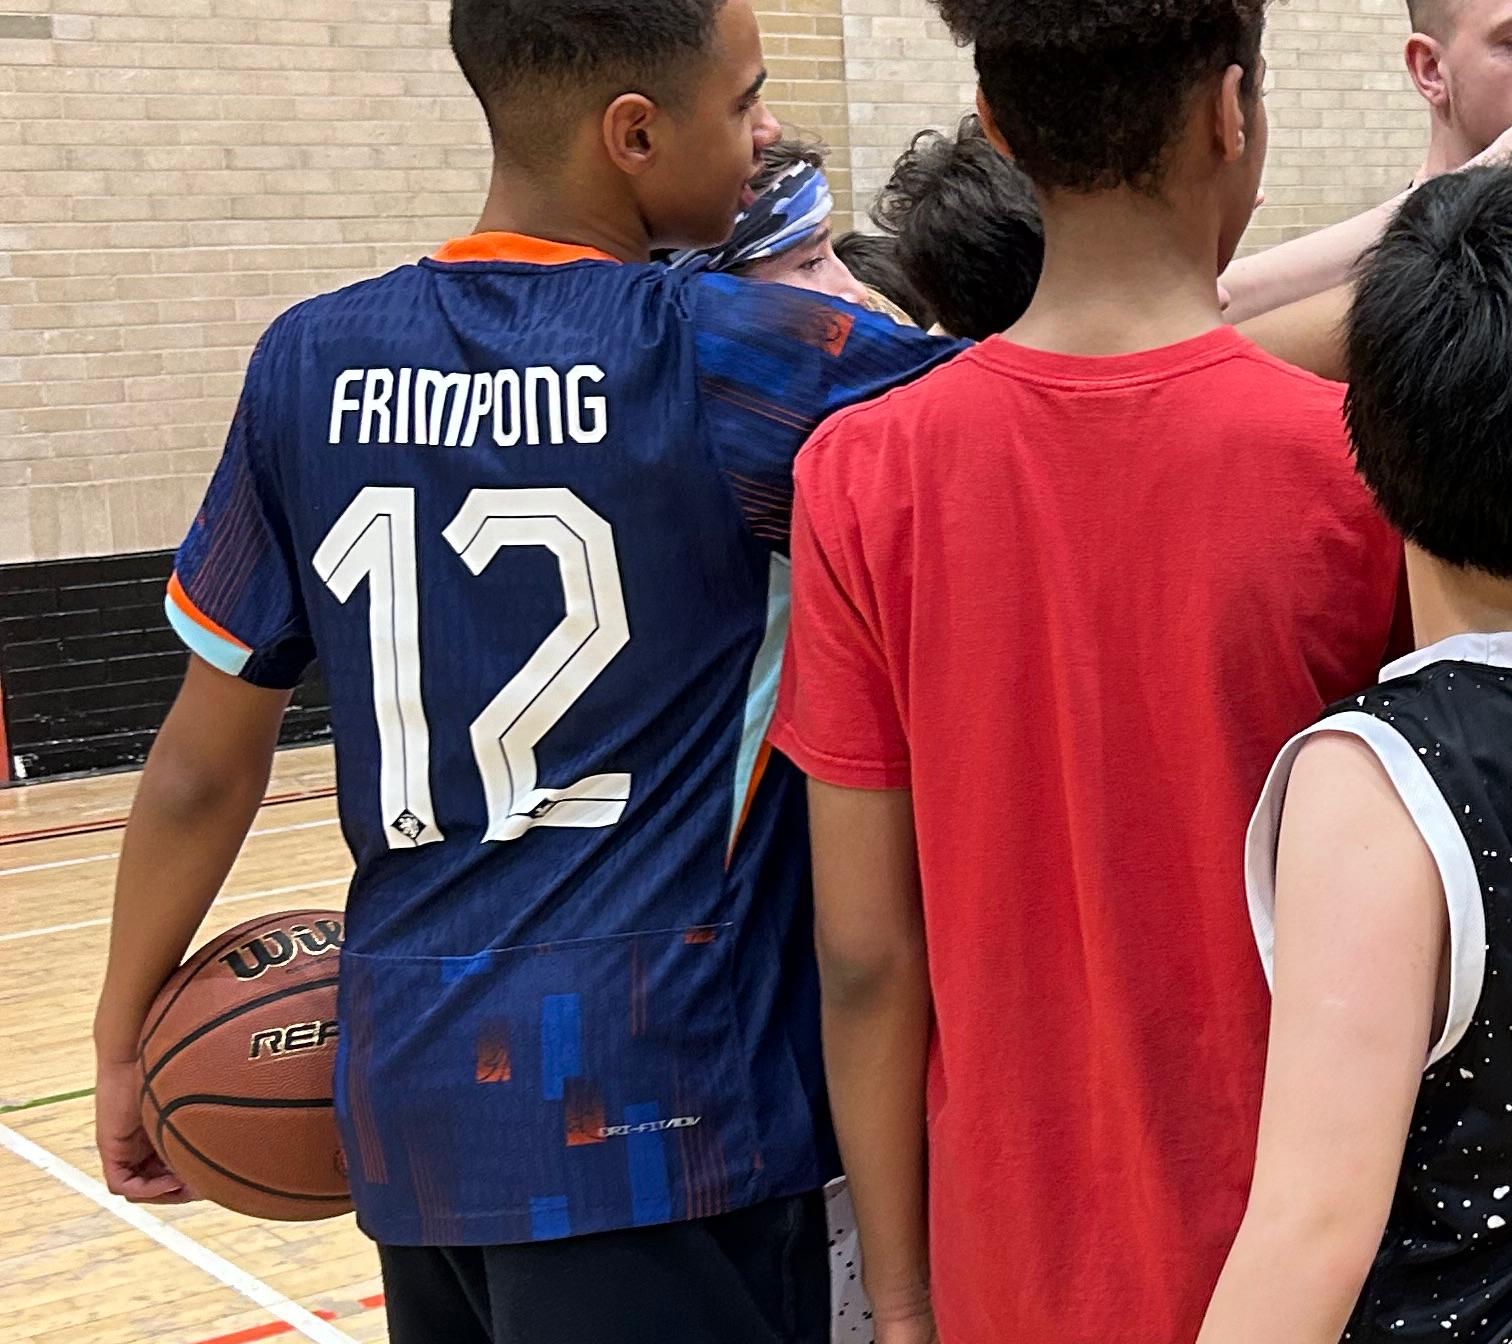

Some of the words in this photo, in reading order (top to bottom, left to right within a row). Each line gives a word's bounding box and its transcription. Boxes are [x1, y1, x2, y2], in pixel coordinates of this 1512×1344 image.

[328, 364, 608, 447] FRIMPONG
[312, 486, 632, 849] 12
[218, 919, 345, 981] Wil
[248, 1021, 340, 1060] REA
